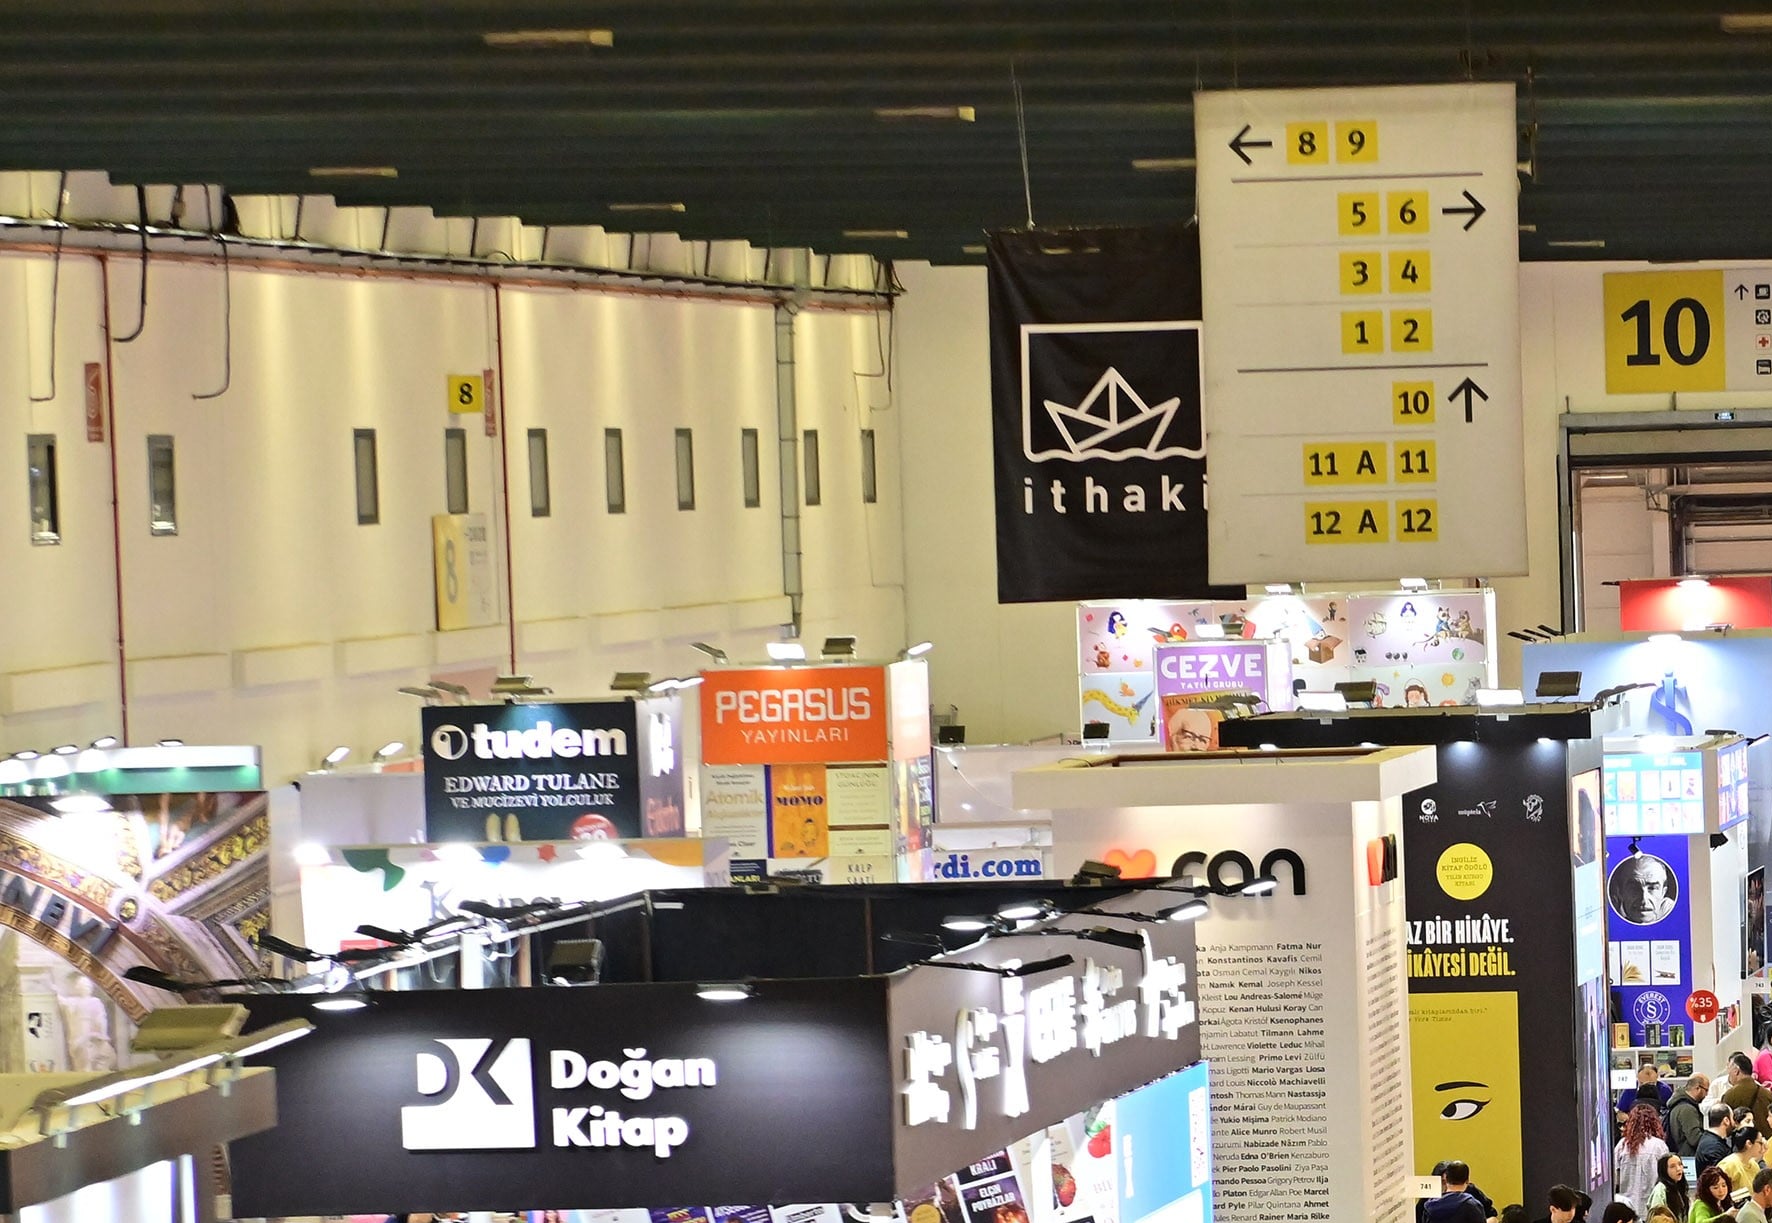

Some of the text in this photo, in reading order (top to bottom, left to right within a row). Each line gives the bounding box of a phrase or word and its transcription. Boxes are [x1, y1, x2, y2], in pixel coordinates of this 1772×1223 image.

[1298, 129, 1366, 156] 8 9
[1351, 198, 1417, 227] 5 6
[1352, 259, 1419, 287] 3 4
[1354, 318, 1420, 345] 1 2
[1620, 298, 1710, 366] 10
[458, 383, 474, 405] 8
[1398, 390, 1430, 415] 10
[1309, 449, 1430, 477] 11 A 11
[1024, 476, 1208, 515] ithaki
[1310, 508, 1433, 536] 12 A 12
[1161, 653, 1262, 679] CEZVE
[715, 688, 871, 724] PEGASUS
[471, 721, 627, 759] tudem
[740, 727, 849, 744] YAYINLARI
[443, 773, 619, 793] EDWARD TULANE
[451, 796, 470, 809] VE
[776, 796, 824, 806] MOMO
[1171, 848, 1306, 898] can
[1425, 915, 1452, 944] BİR
[1455, 913, 1514, 944] HİKÂYE.
[1207, 955, 1263, 964] Konstantinos
[1469, 946, 1516, 976] DEĞİL.
[1238, 980, 1263, 988] Kemal
[1690, 997, 1713, 1008] %35
[550, 1048, 718, 1101] Doğan
[552, 1112, 690, 1159] Kitap
[970, 1160, 997, 1176] KRALI
[1420, 1182, 1432, 1190] 741
